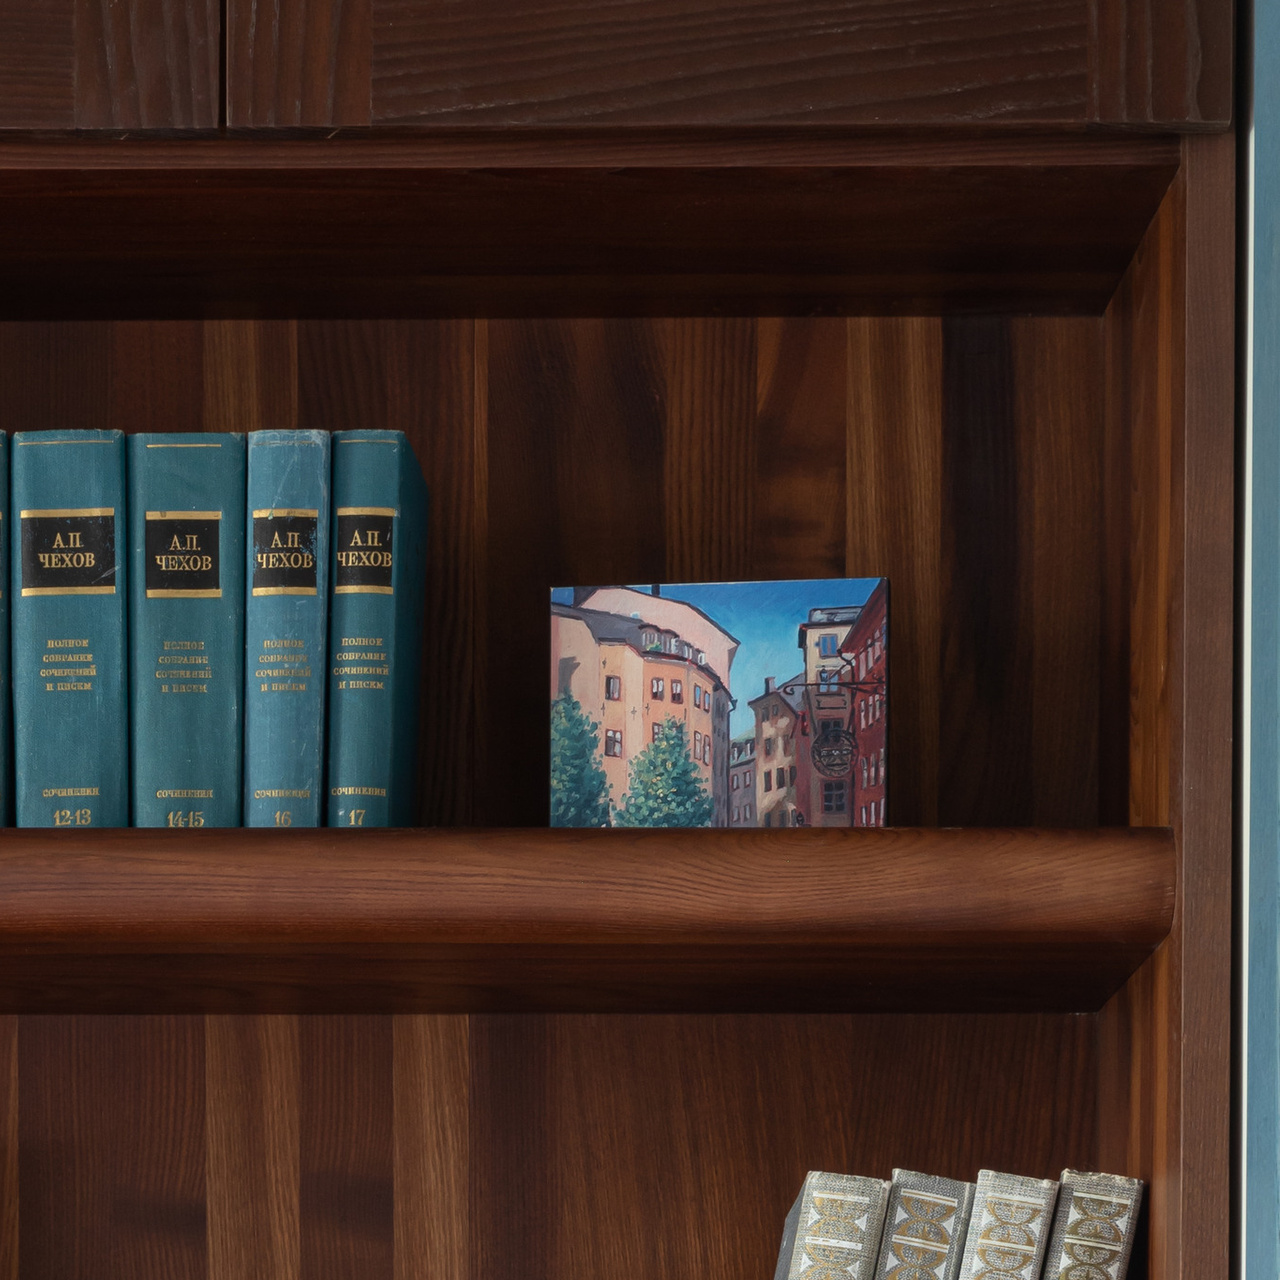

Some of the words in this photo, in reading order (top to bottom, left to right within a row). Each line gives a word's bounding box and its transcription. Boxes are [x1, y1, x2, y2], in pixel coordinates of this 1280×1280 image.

[52, 532, 82, 549] А.П.
[169, 534, 203, 551] А.П.
[270, 531, 302, 548] А.П.
[349, 530, 383, 547] А.П.
[39, 552, 96, 568] ЧЕХОВ
[154, 554, 213, 571] ЧЕХОВ
[256, 552, 313, 569] ЧЕХОВ
[337, 550, 393, 568] ЧЕХОВ
[53, 808, 92, 827] 12-13
[167, 811, 205, 828] 14-15
[274, 811, 292, 828] 16
[349, 809, 366, 826] 17
